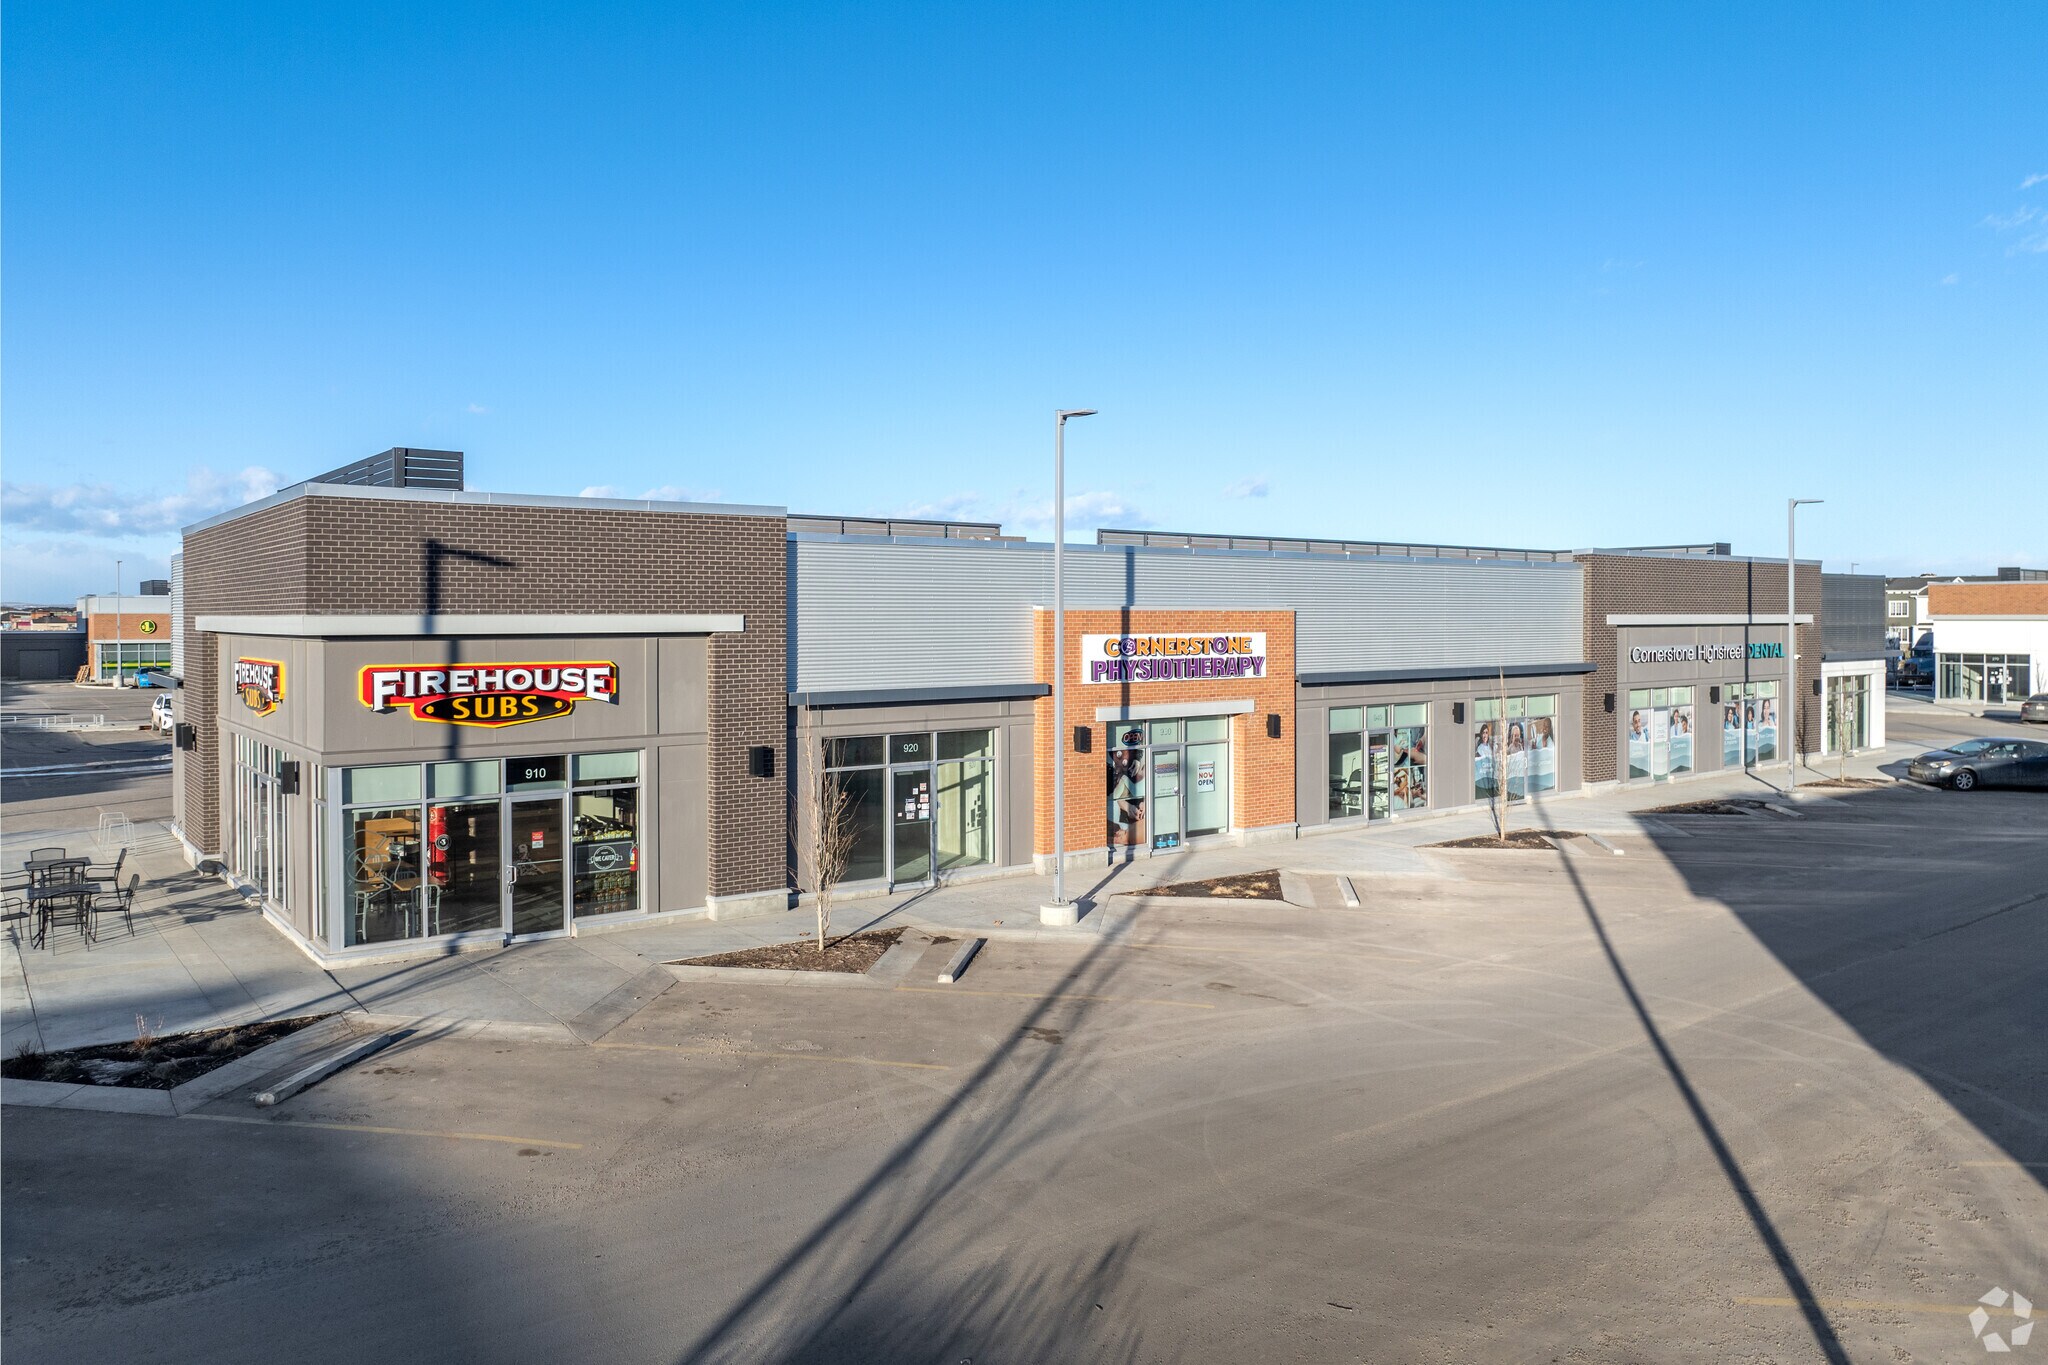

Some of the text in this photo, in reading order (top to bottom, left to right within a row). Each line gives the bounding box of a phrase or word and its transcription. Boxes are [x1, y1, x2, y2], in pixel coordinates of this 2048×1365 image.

[1105, 637, 1252, 657] CORNERSTONE
[1631, 643, 1785, 663] Cornerstone Highstreet DENTAL
[1092, 656, 1265, 682] PHYSIOTHERAPY
[234, 661, 274, 701] FIREHOUSE
[371, 666, 611, 712] FIREHOUSE
[245, 688, 260, 708] SUBS
[453, 695, 540, 719] SUBS
[1123, 733, 1143, 742] OPEN
[903, 743, 919, 753] 920
[525, 767, 547, 779] 910
